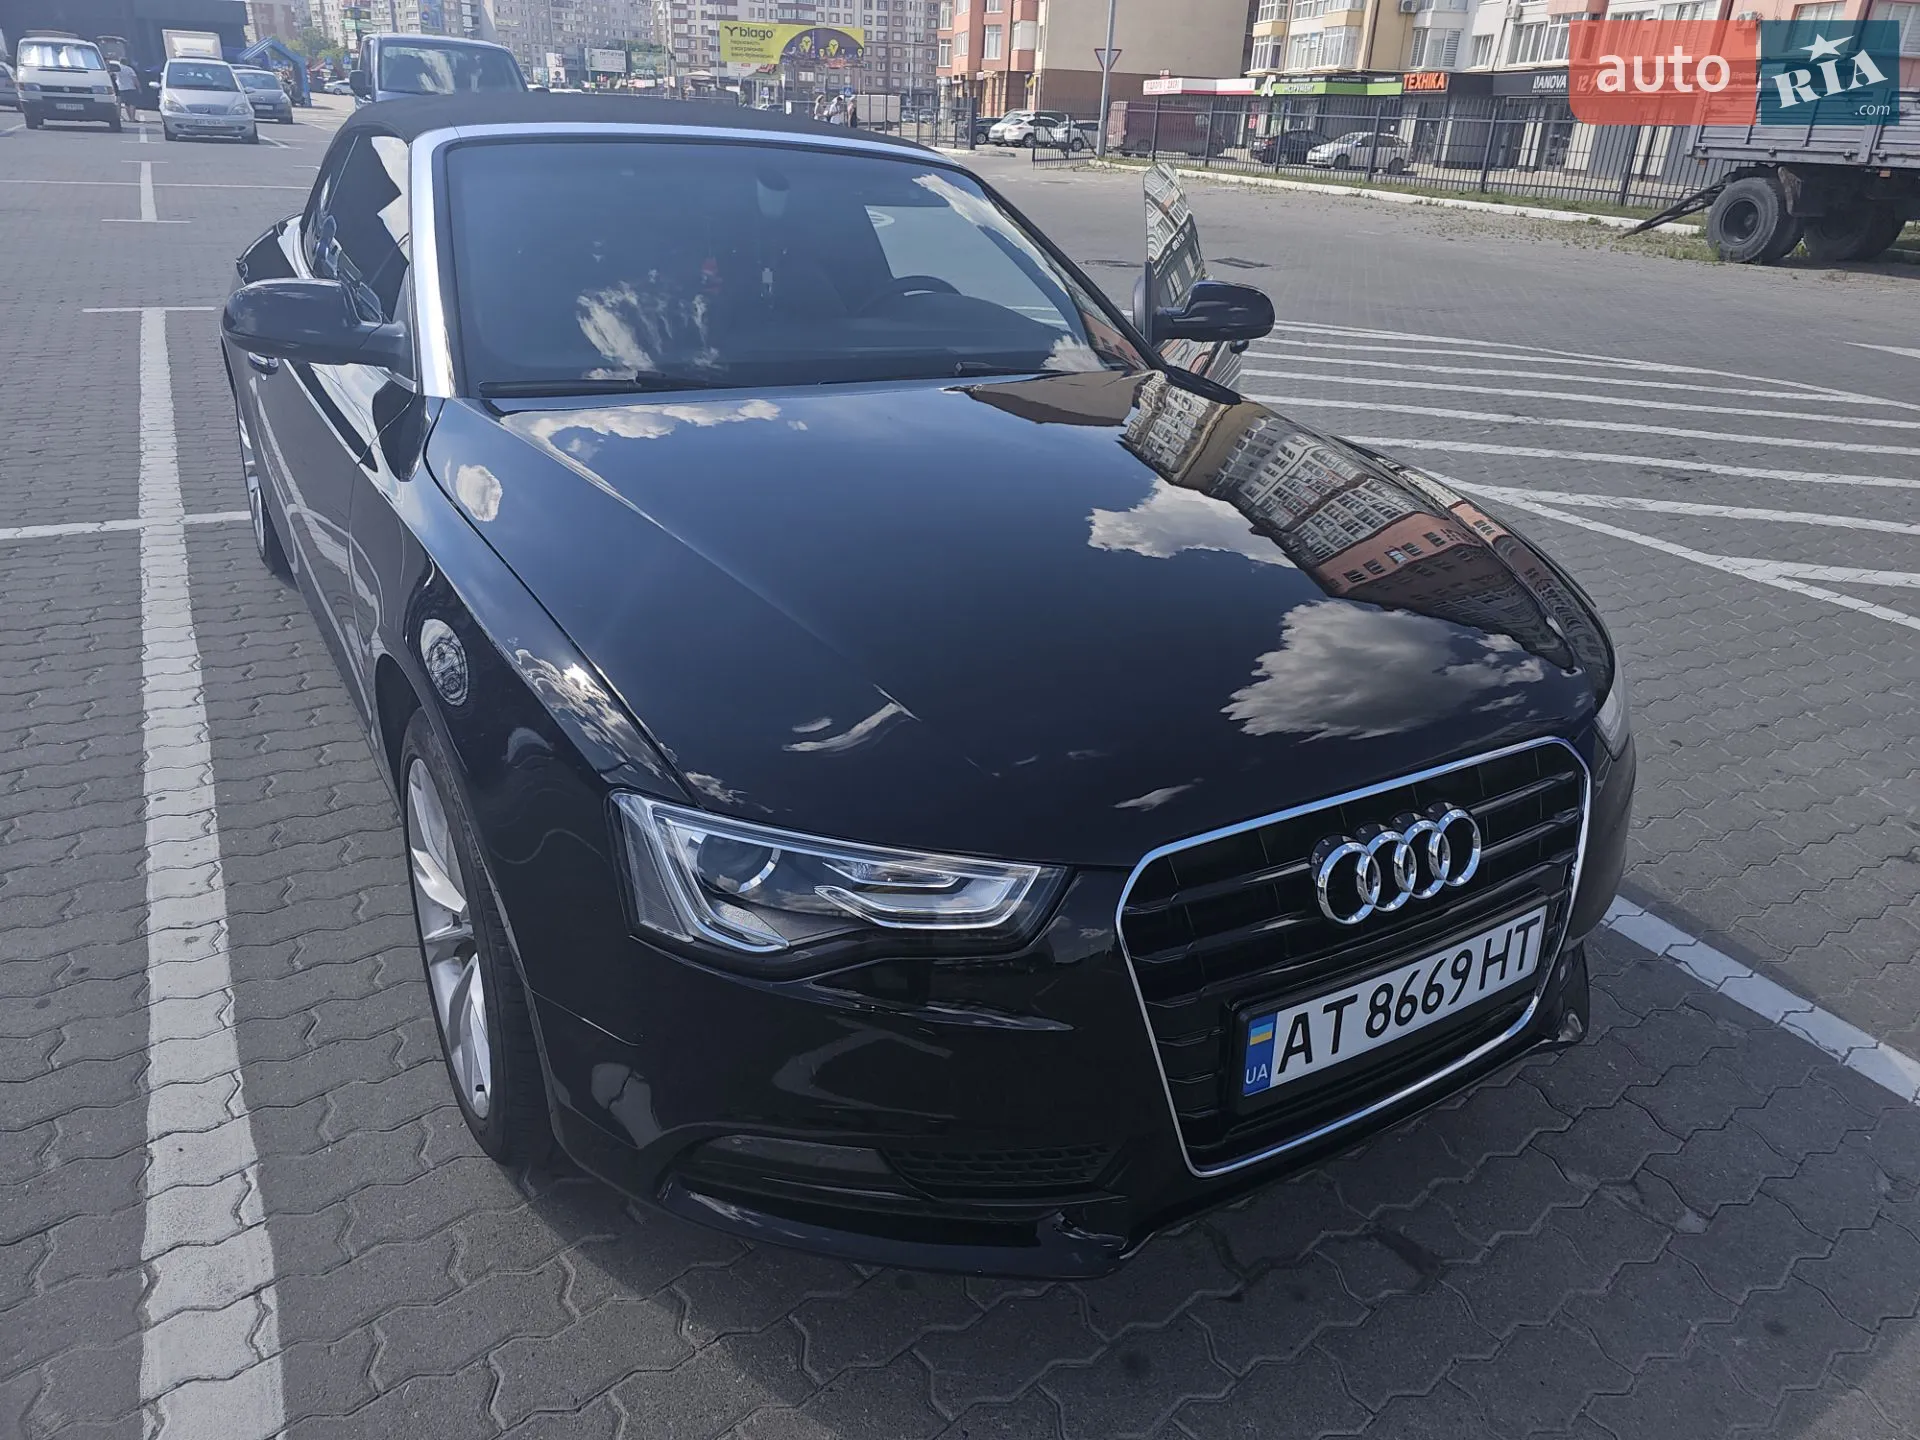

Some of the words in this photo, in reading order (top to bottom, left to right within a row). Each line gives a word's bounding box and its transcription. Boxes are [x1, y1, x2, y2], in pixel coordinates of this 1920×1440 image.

[1403, 73, 1445, 89] ТЕХНІКА
[1277, 994, 1358, 1074] AT
[1365, 949, 1473, 1038] 8669
[1479, 915, 1541, 991] HT
[1245, 1063, 1268, 1085] UA
